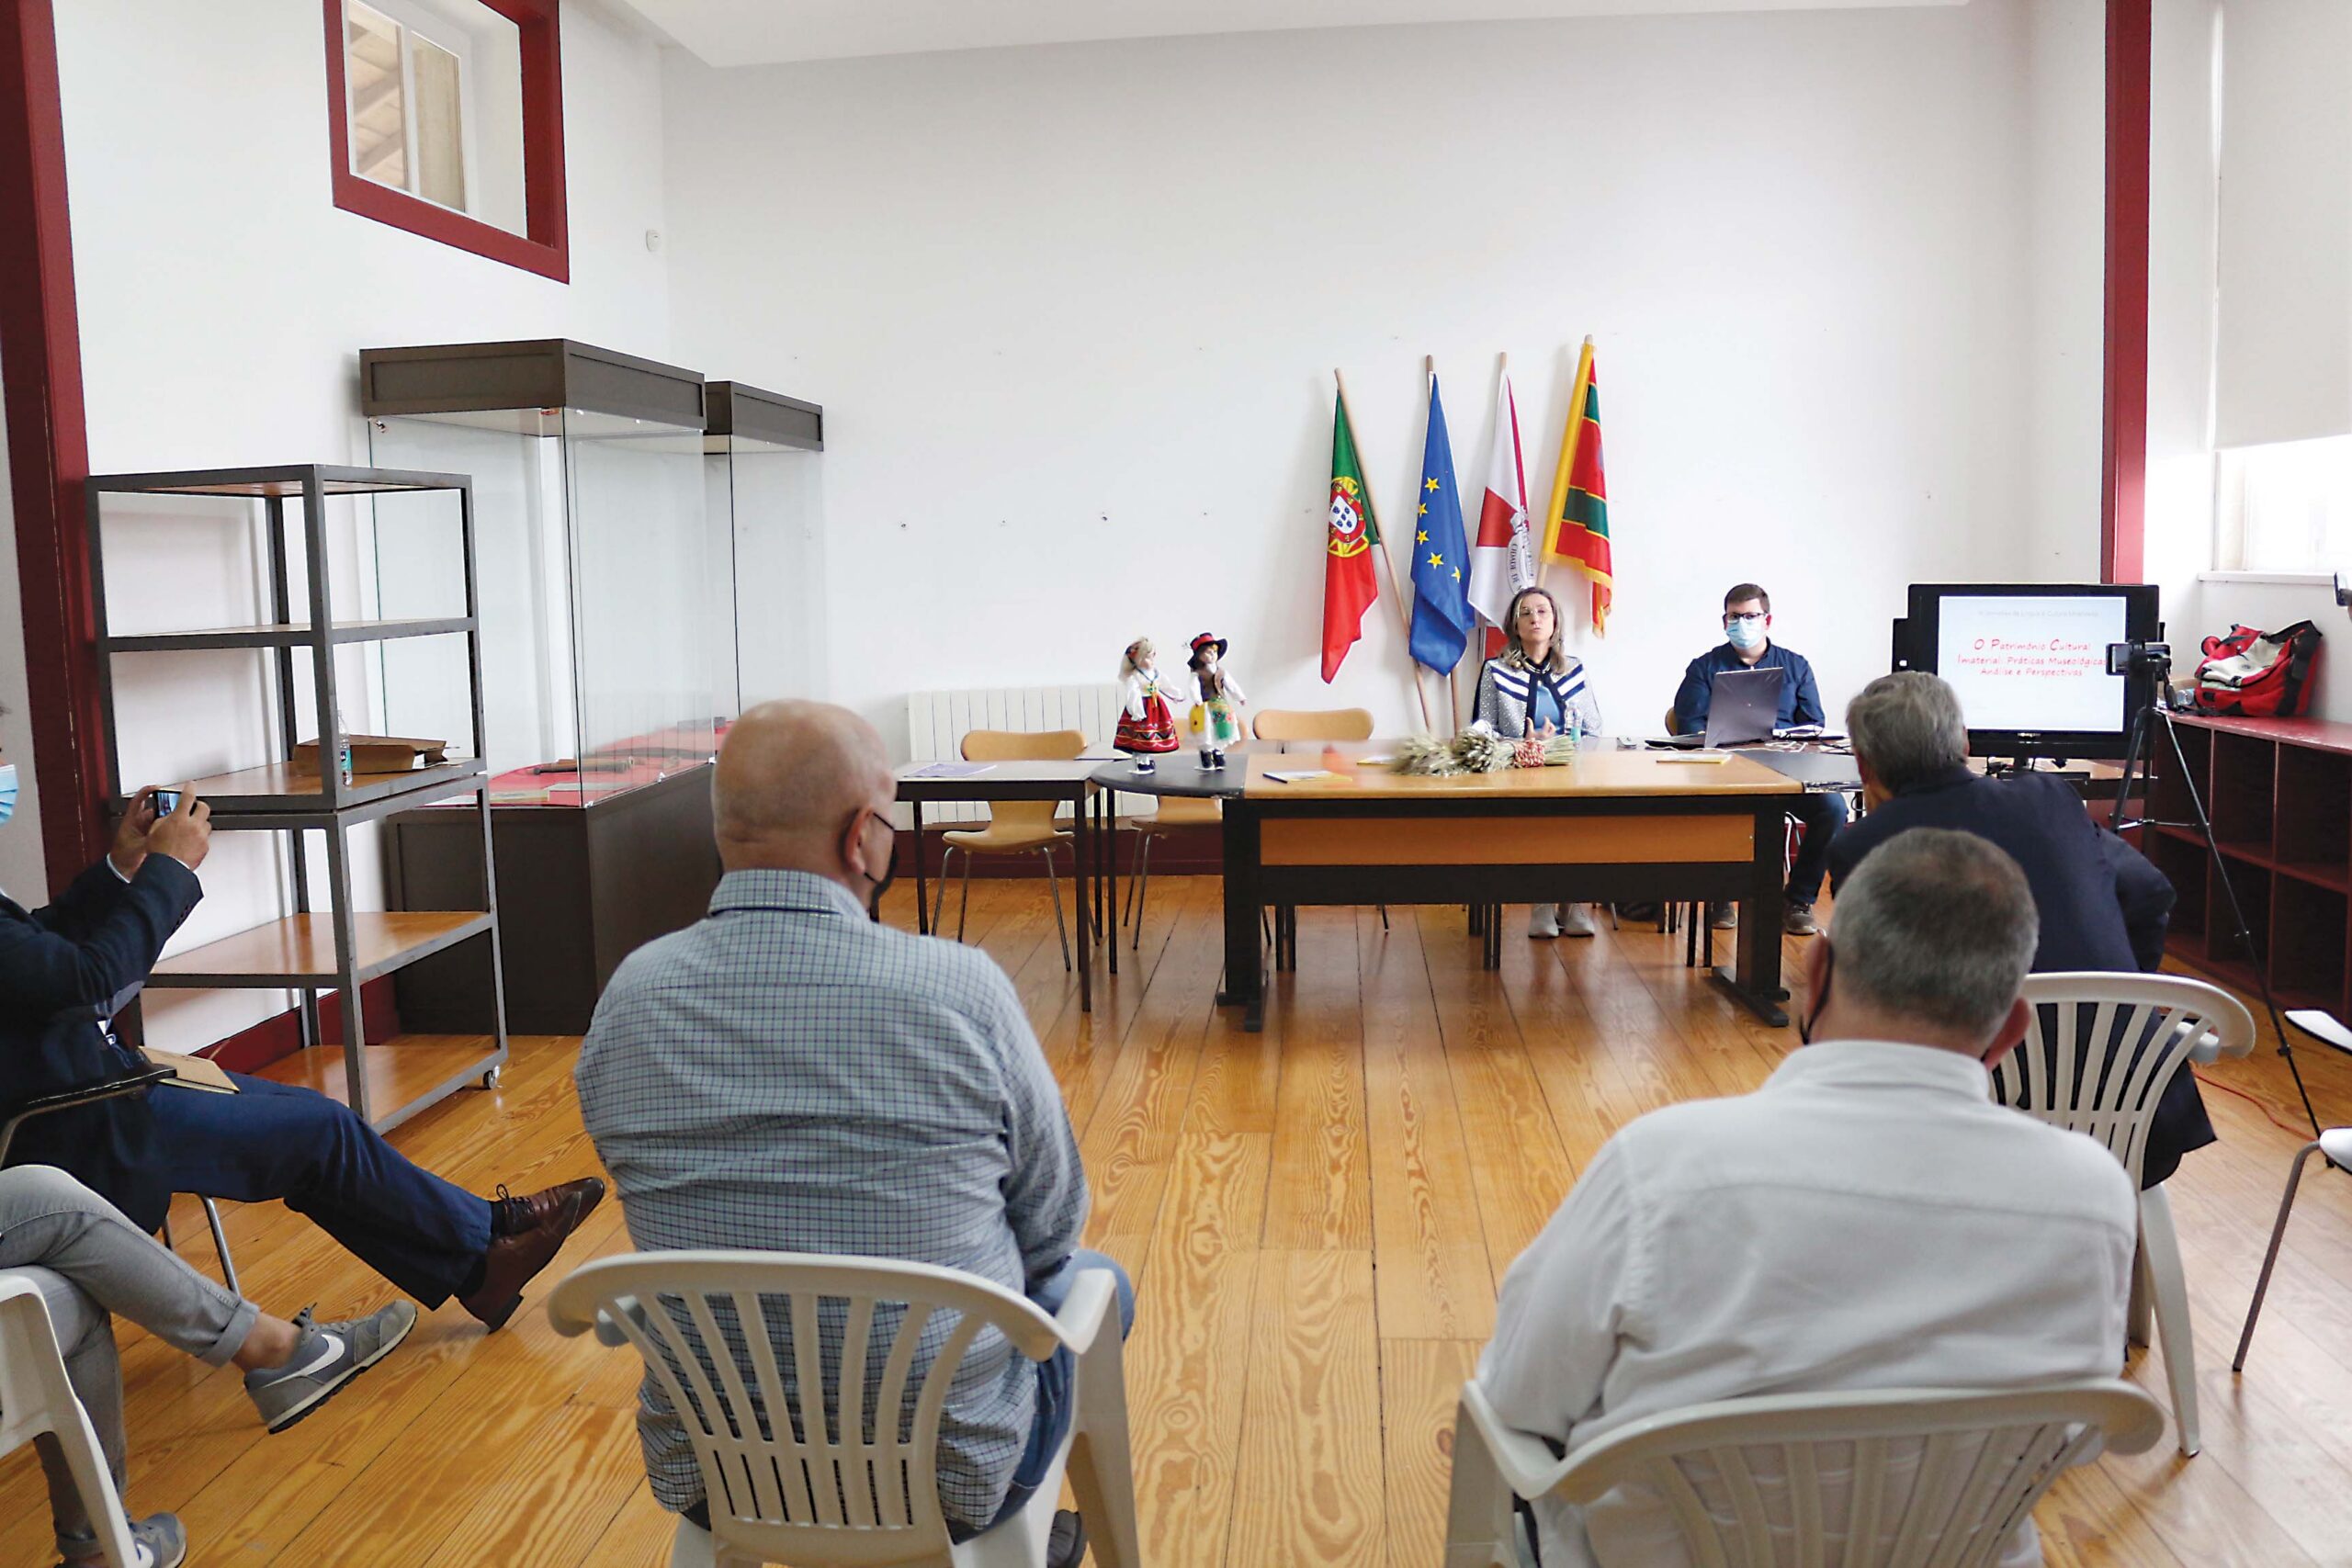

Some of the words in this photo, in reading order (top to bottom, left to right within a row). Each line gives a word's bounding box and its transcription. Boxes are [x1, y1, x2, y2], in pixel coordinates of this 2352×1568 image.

[1974, 638, 1984, 650] O
[2050, 638, 2091, 651] Cultural
[2007, 656, 2044, 665] Práticas
[2026, 668, 2083, 678] Perspectivas
